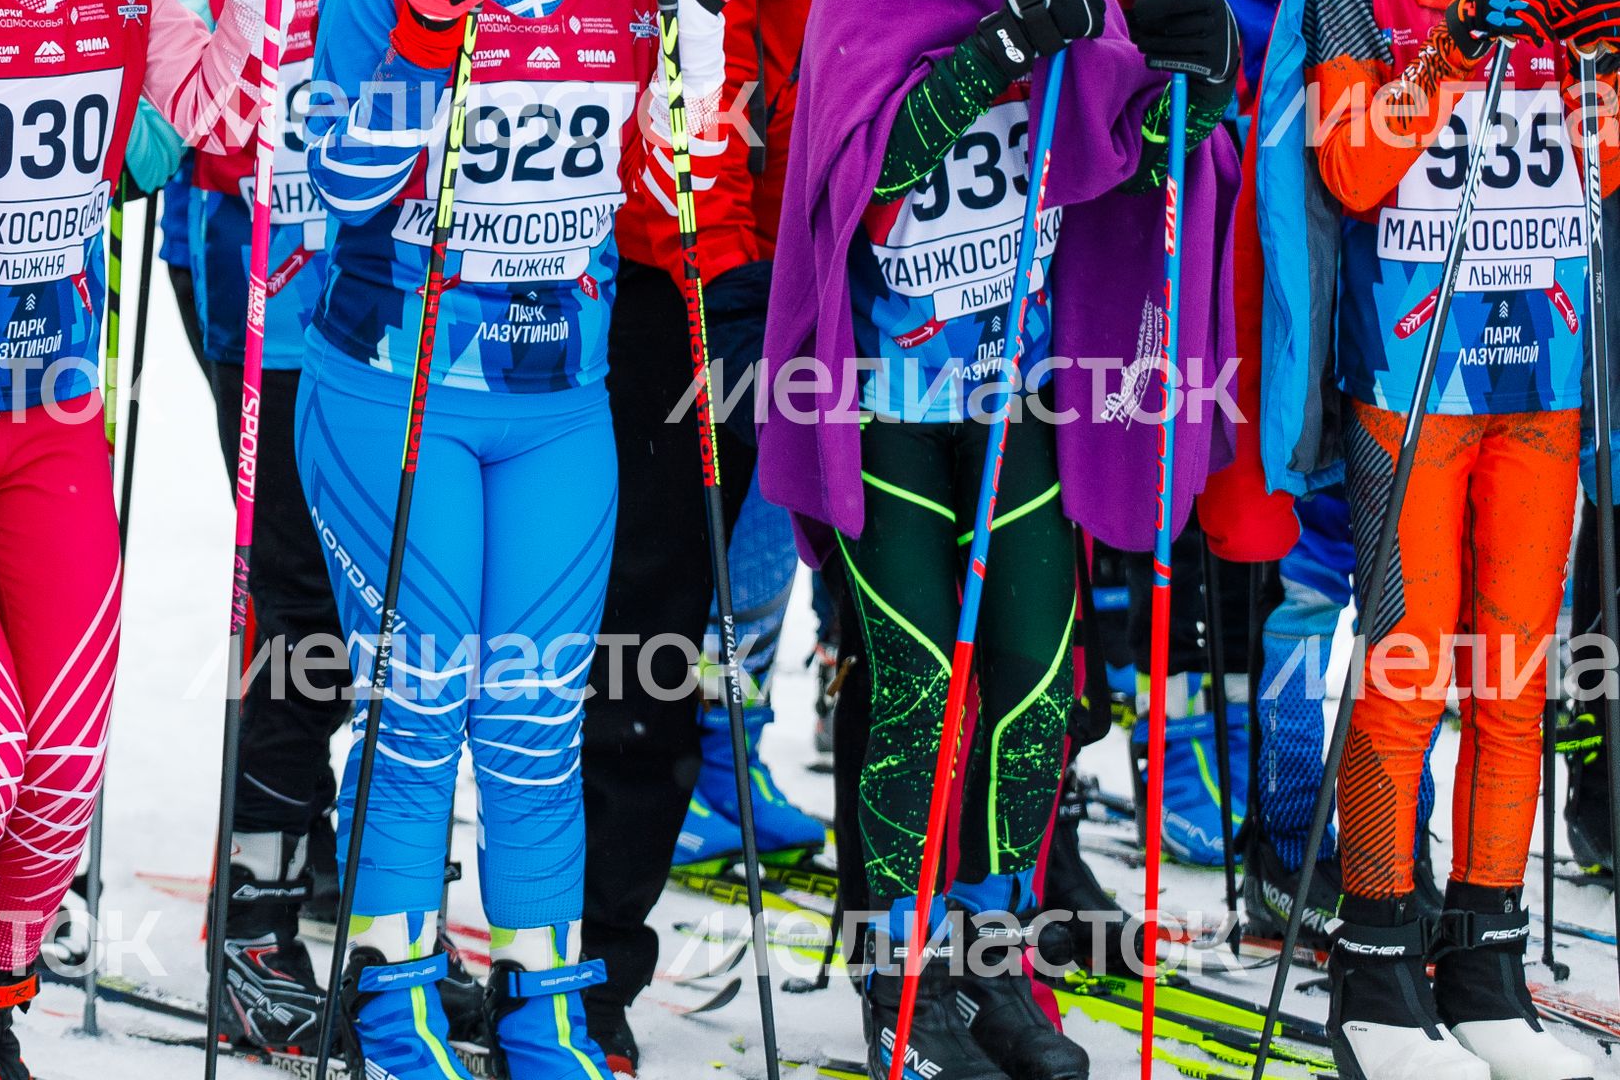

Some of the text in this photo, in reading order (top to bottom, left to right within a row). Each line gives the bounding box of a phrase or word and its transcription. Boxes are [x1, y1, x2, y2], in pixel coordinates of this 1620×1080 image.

[478, 14, 511, 24] ПАРКИ
[480, 23, 559, 34] ПОДМОСКОВЬЯ
[76, 37, 110, 53] ЗИМА
[577, 49, 616, 64] ЗИМА
[461, 103, 611, 185] 928
[1425, 112, 1565, 190] 935
[490, 256, 566, 278] ЛЫЖНЯ
[1469, 263, 1532, 287] ЛЫЖНЯ
[509, 303, 547, 323] ПАРК
[7, 317, 47, 339] ПАРК
[477, 316, 570, 344] ЛАЗУТИНОЙ
[1484, 326, 1522, 345] ПАРК
[1459, 340, 1540, 367] ЛАЗУТИНОЙ
[237, 391, 260, 496] SPORT
[976, 924, 1034, 940] SPINE
[1337, 936, 1406, 957] FISCHER
[376, 964, 438, 984] SPINE
[539, 970, 594, 988] SPINE
